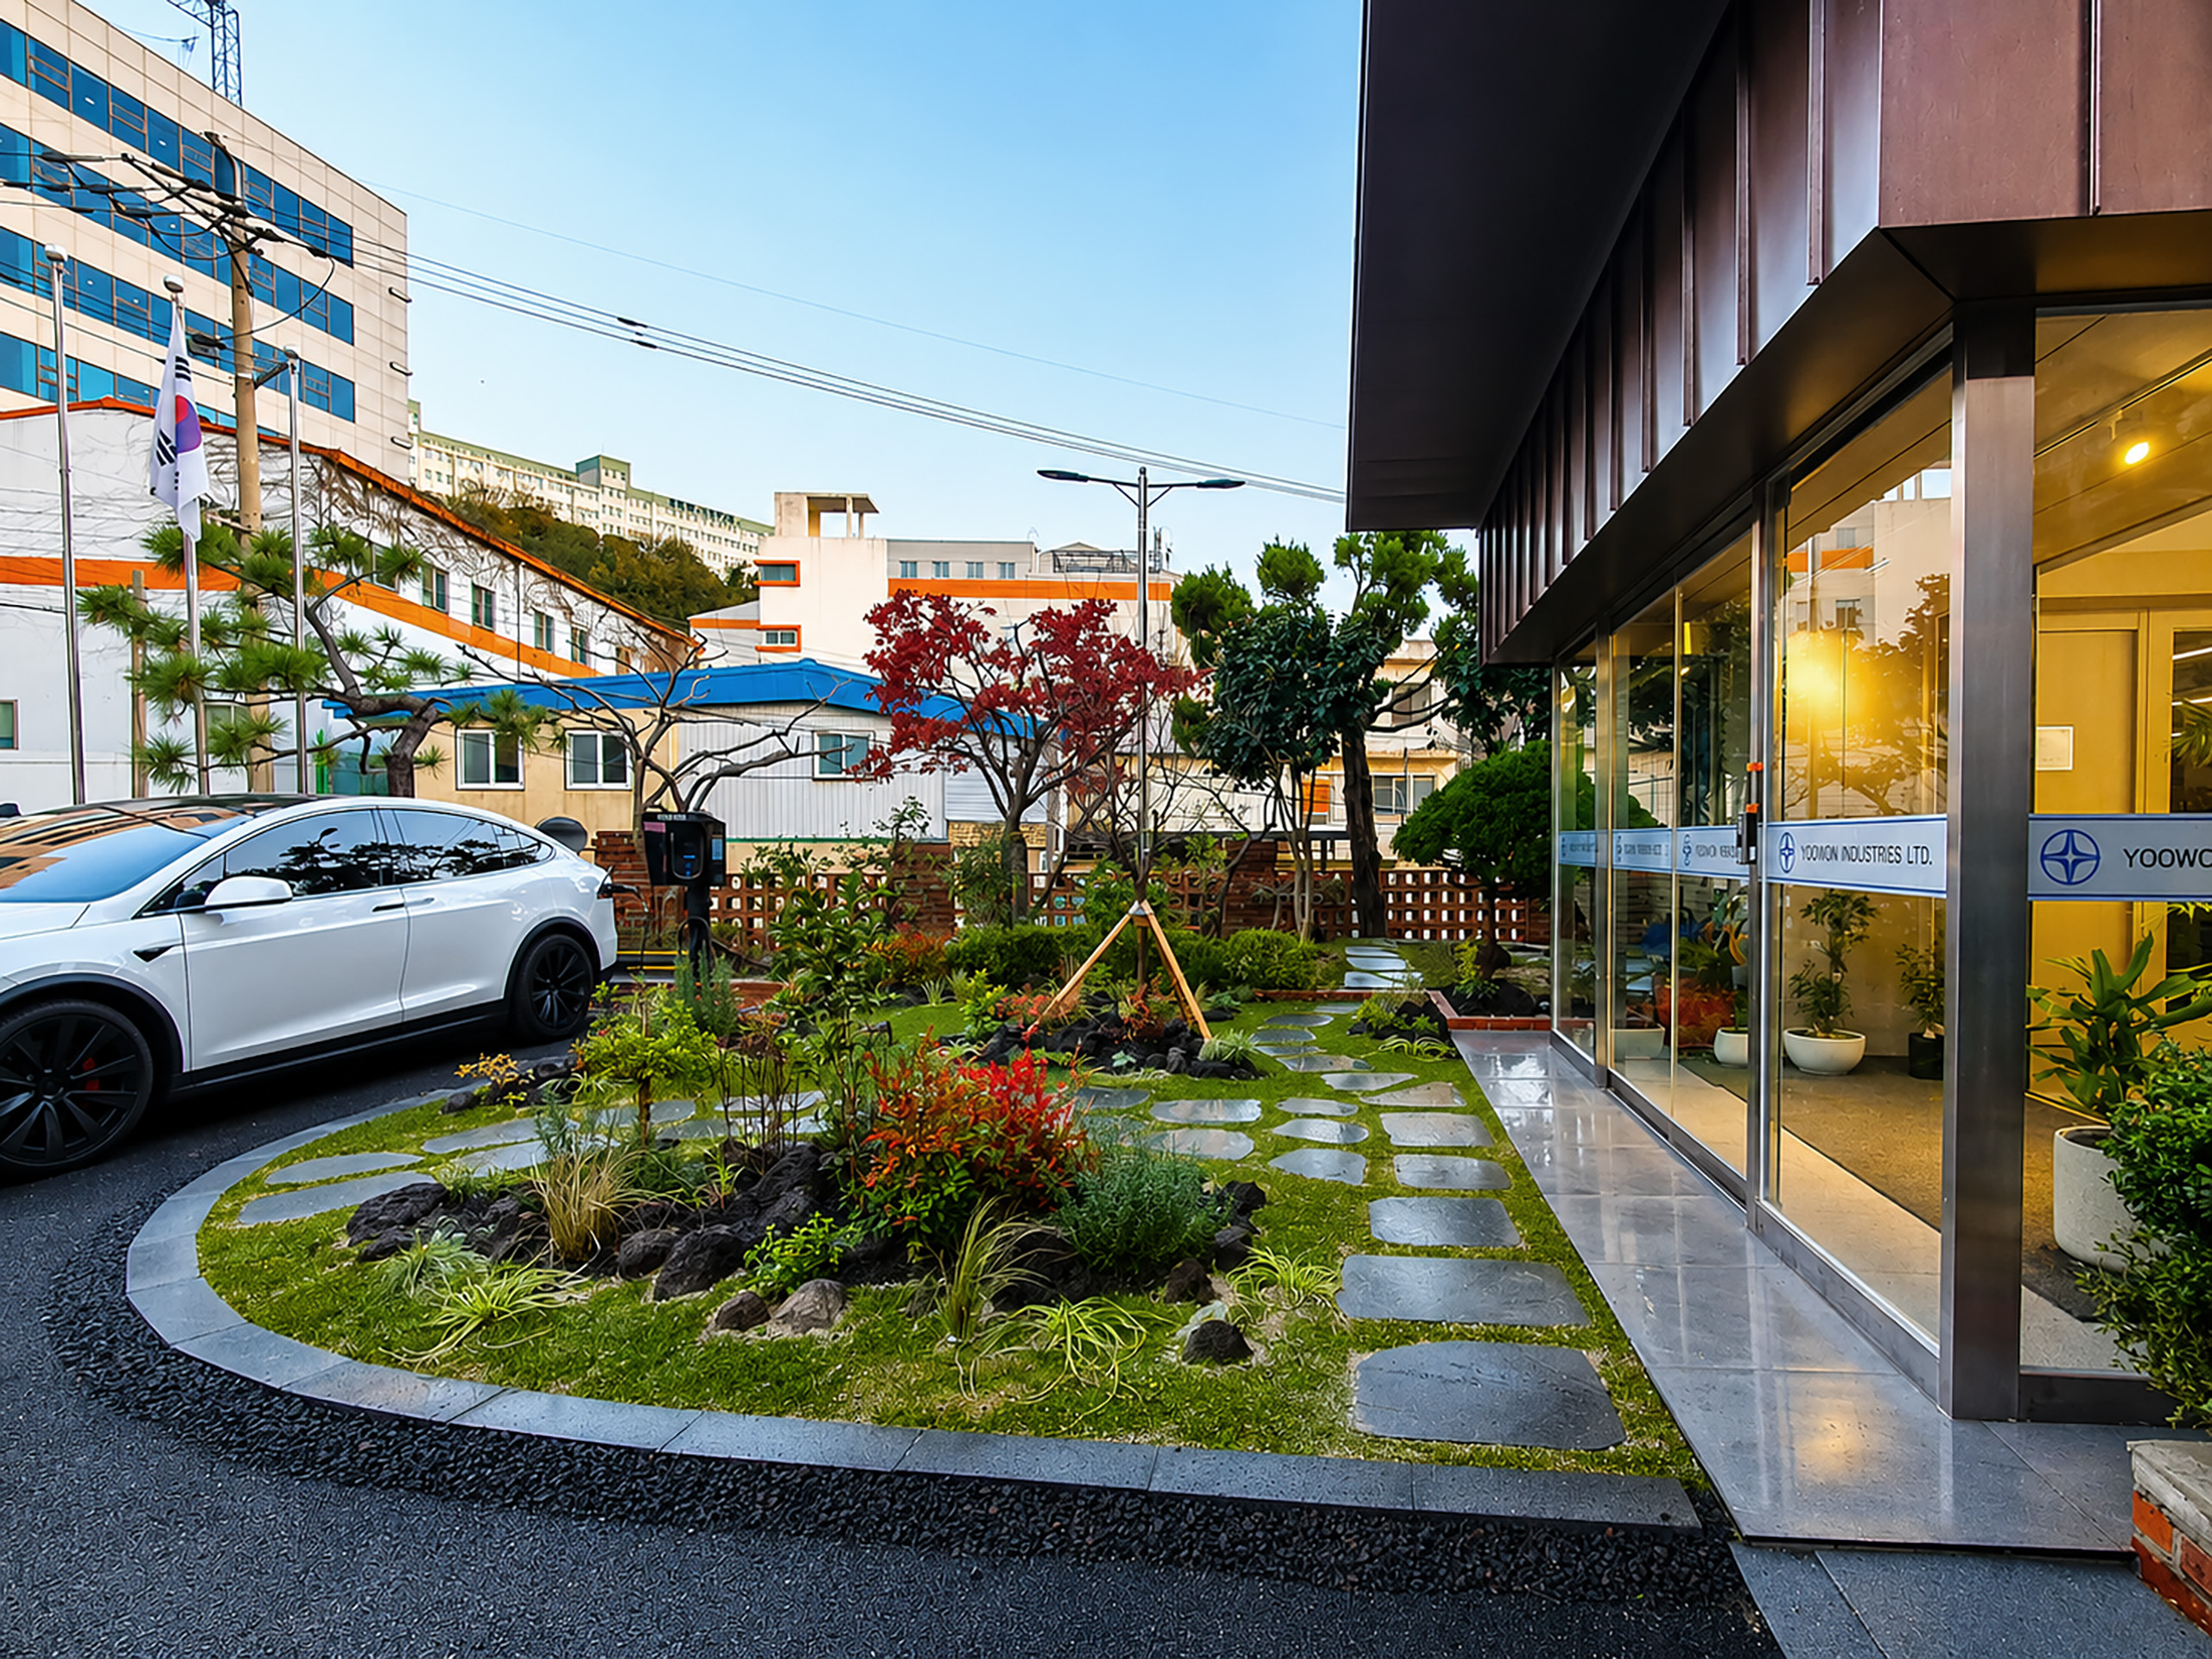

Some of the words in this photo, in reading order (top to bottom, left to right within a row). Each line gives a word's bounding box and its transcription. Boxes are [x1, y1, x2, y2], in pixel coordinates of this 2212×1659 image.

[1801, 844, 1839, 862] YOOWON
[1841, 845, 1902, 864] INDUSTRIES
[1907, 845, 1933, 865] LTD.
